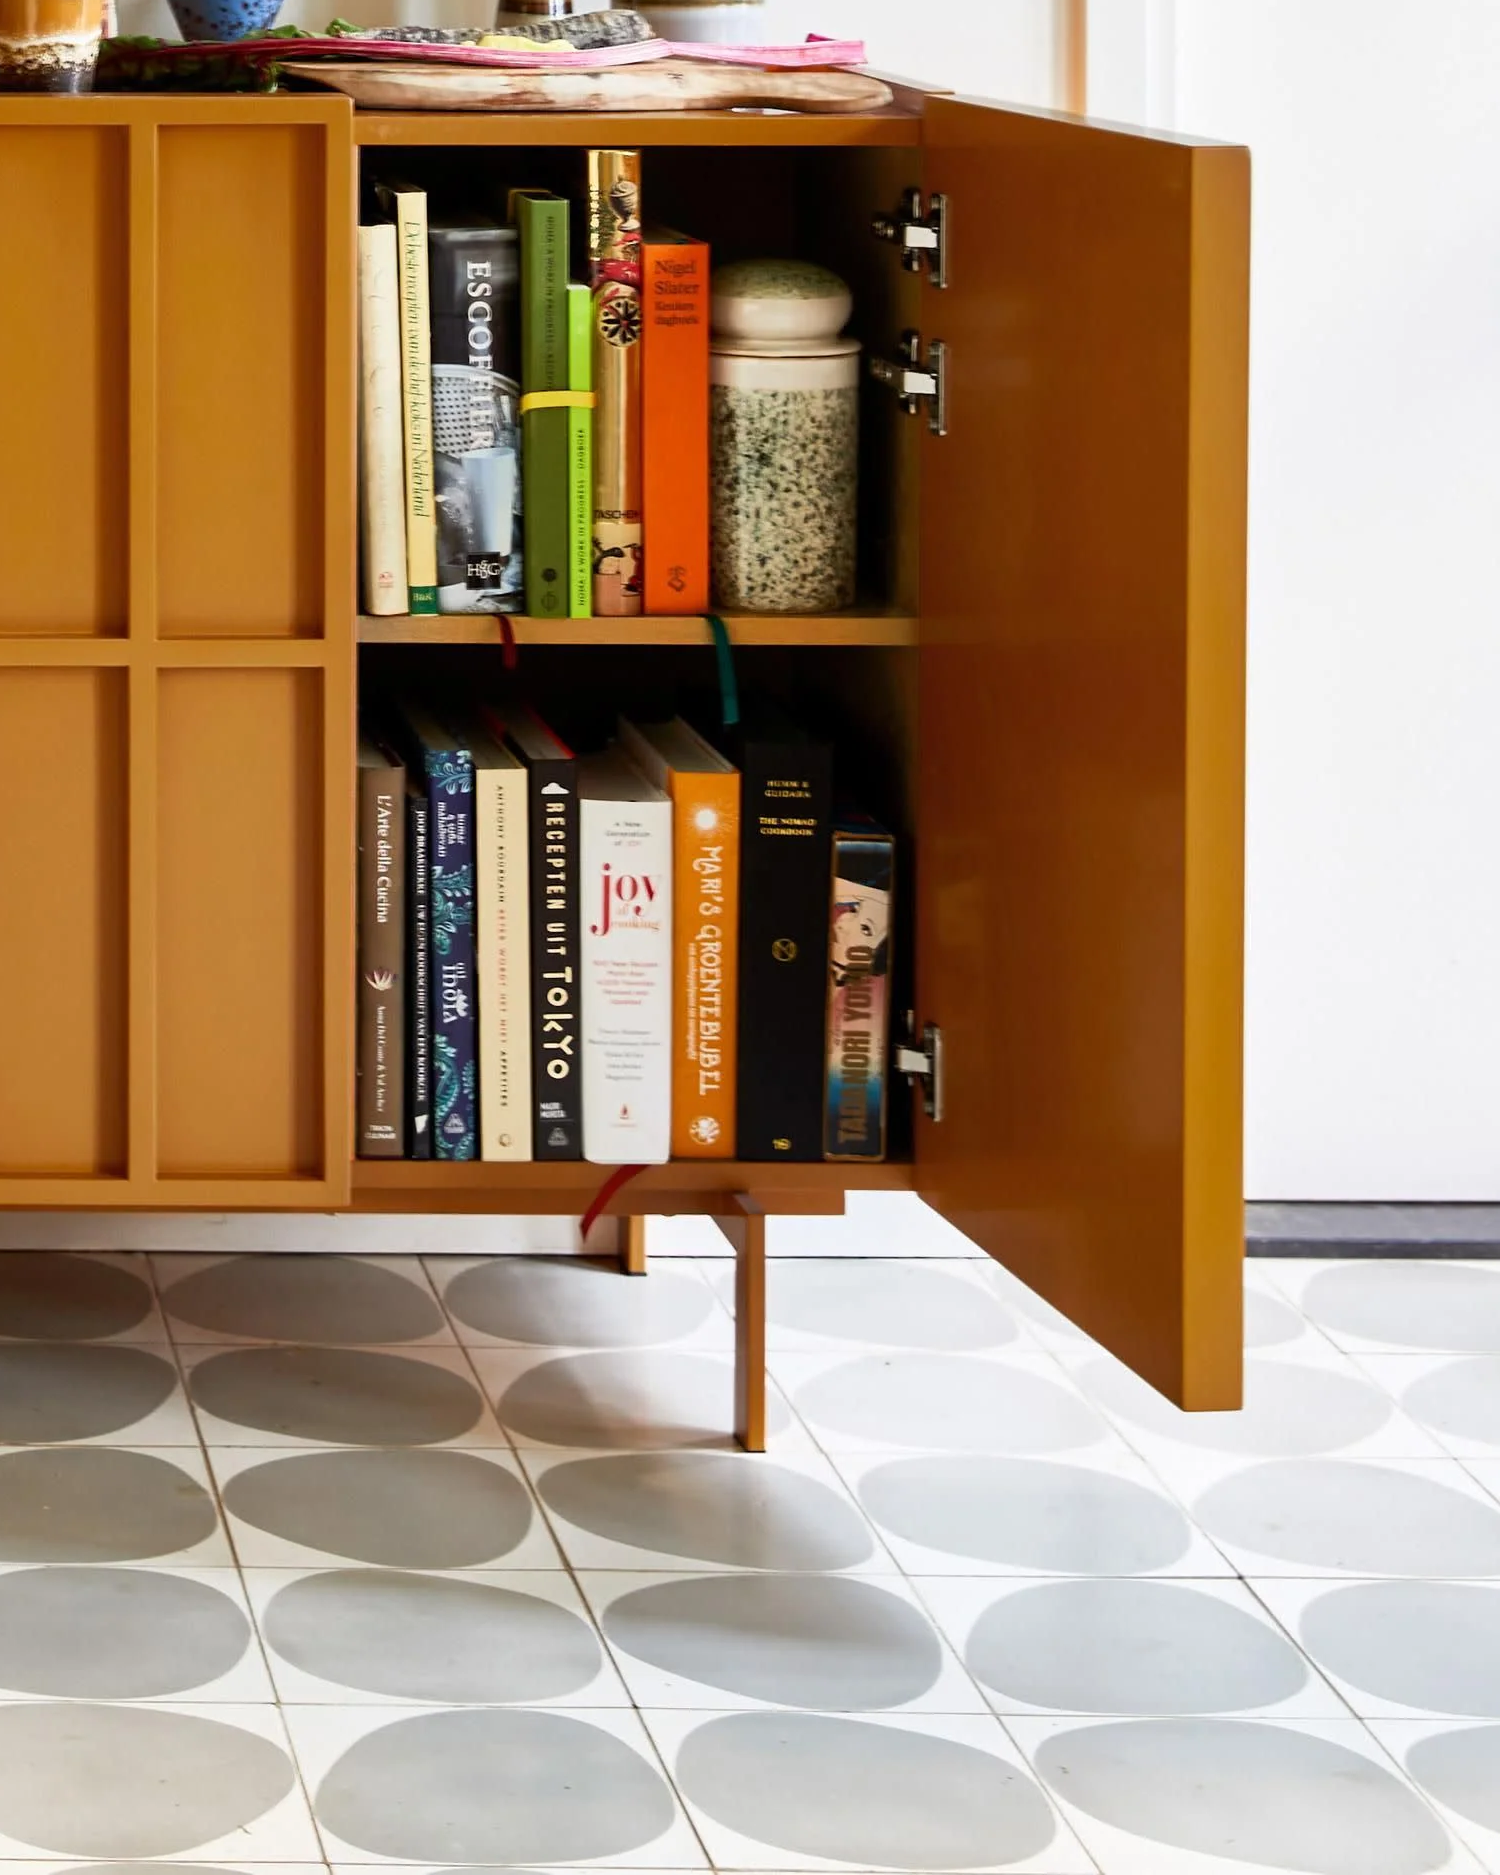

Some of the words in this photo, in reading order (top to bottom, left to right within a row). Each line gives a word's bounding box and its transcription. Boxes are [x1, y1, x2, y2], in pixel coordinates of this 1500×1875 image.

[655, 258, 697, 278] Nigel
[655, 280, 700, 295] Slater
[402, 275, 422, 324] recepten
[466, 260, 494, 451] ESCOFFIER
[411, 447, 431, 518] Nederland
[377, 795, 393, 837] L'Arte
[415, 810, 426, 833] JOOP
[377, 840, 393, 872] della
[497, 845, 505, 903] BOURDAIN
[546, 802, 566, 910] RECEPTEN
[693, 845, 724, 916] MARI'S
[376, 876, 392, 923] Cucina
[590, 862, 660, 937] joy
[546, 922, 567, 956] UIT
[417, 1018, 426, 1035] VAN
[696, 924, 723, 1095] GROENTEBIJBEL
[837, 1030, 871, 1144] TADANORI
